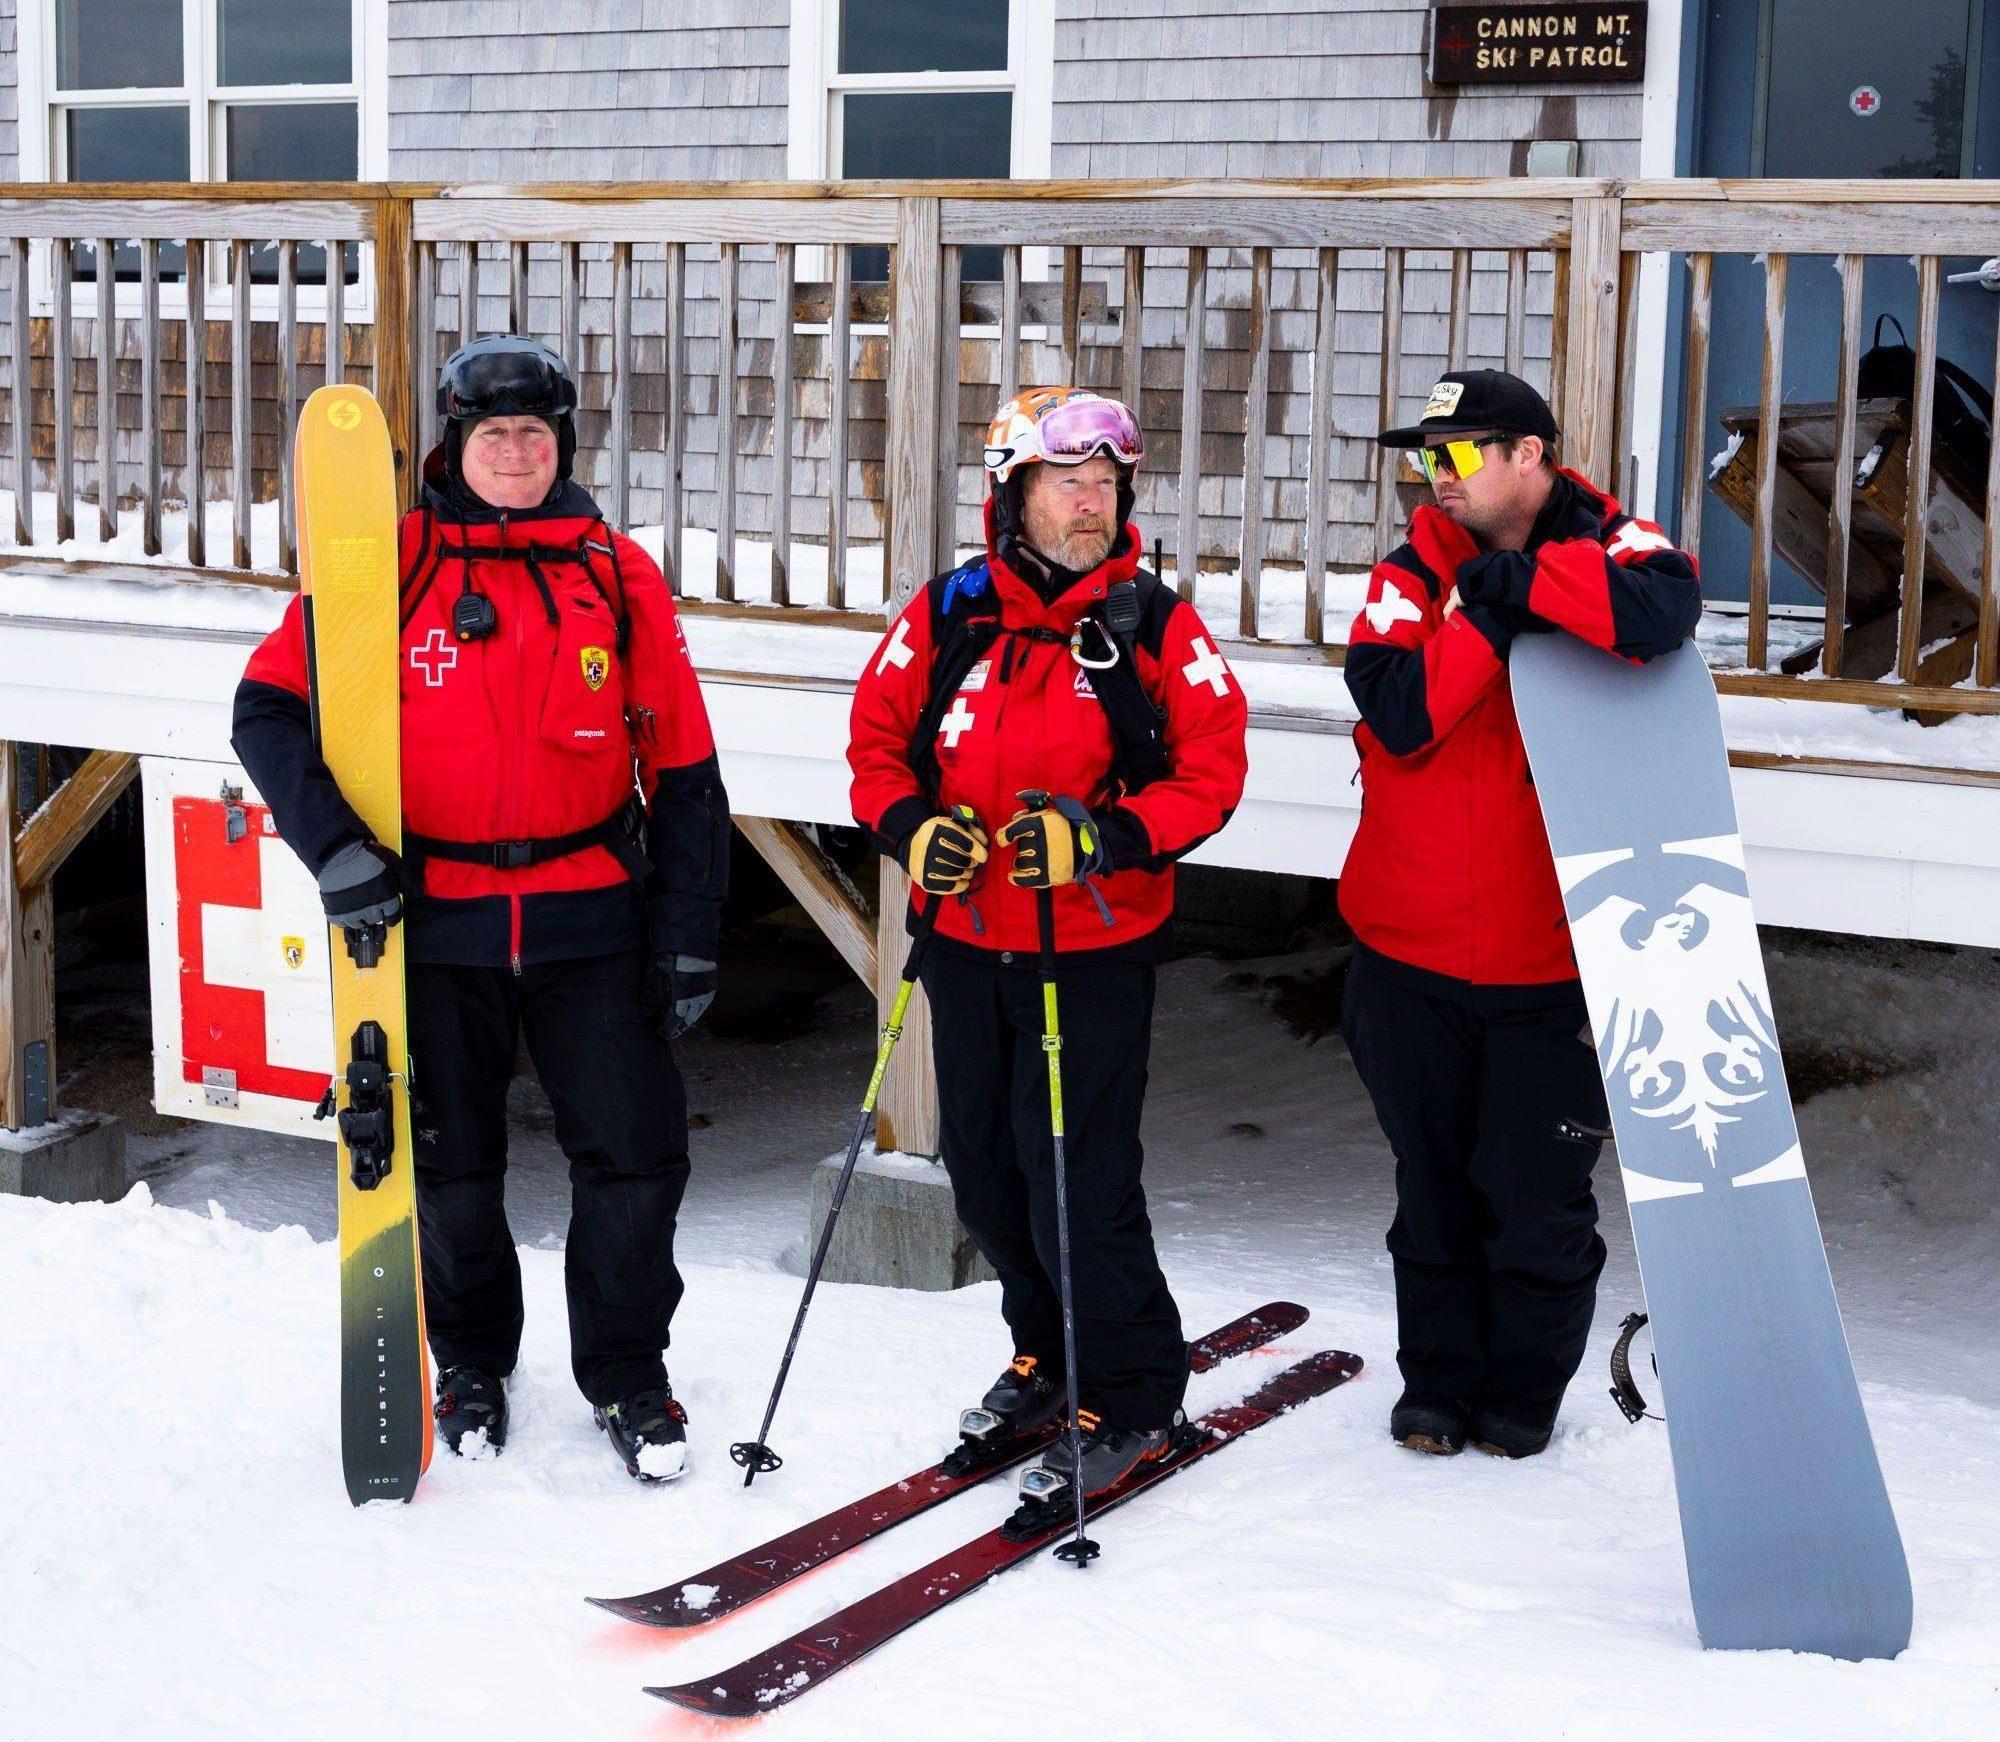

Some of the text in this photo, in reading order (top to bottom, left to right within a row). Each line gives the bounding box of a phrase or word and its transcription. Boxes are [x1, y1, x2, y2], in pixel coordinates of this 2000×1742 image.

[1477, 15, 1577, 38] CANNON
[1476, 46, 1628, 69] SKI PATROL
[574, 729, 606, 739] patagonia
[376, 1307, 388, 1444] RUSTLER 11
